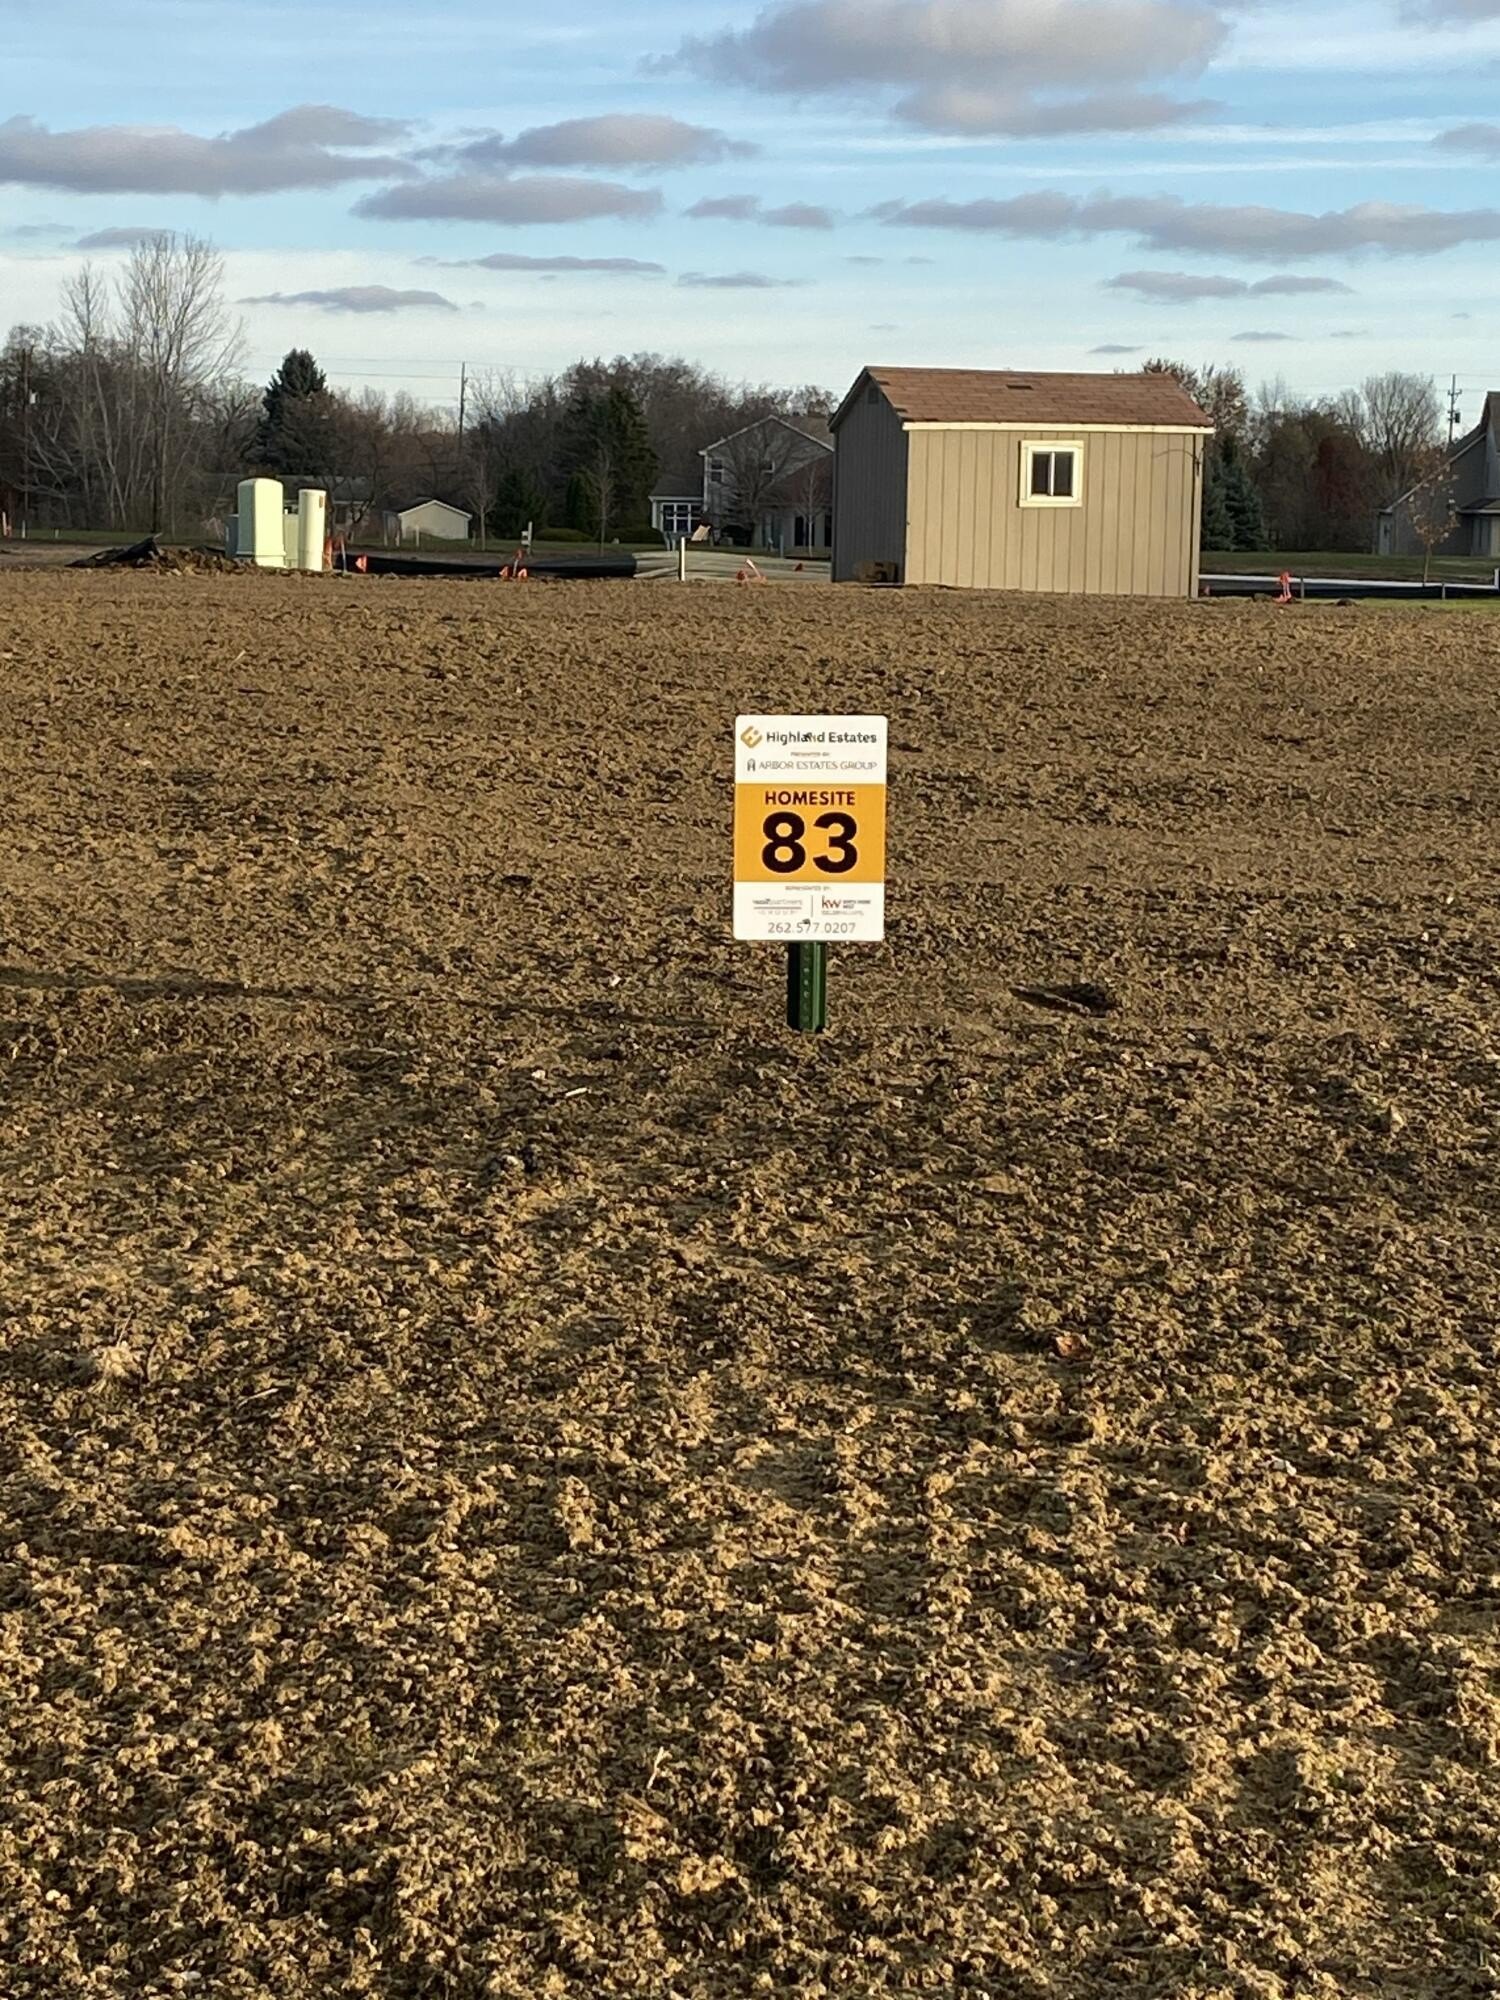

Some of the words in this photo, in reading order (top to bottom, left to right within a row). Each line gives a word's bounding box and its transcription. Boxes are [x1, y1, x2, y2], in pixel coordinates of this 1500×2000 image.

[766, 731, 825, 746] Highland
[828, 732, 877, 743] Estates
[759, 761, 794, 770] ARBOR
[796, 761, 838, 770] ESTATES
[840, 761, 878, 770] GROUP
[765, 791, 856, 805] HOMESITE
[762, 811, 858, 874] 83
[821, 895, 842, 909] kw
[767, 922, 857, 934] 262.577.0207
